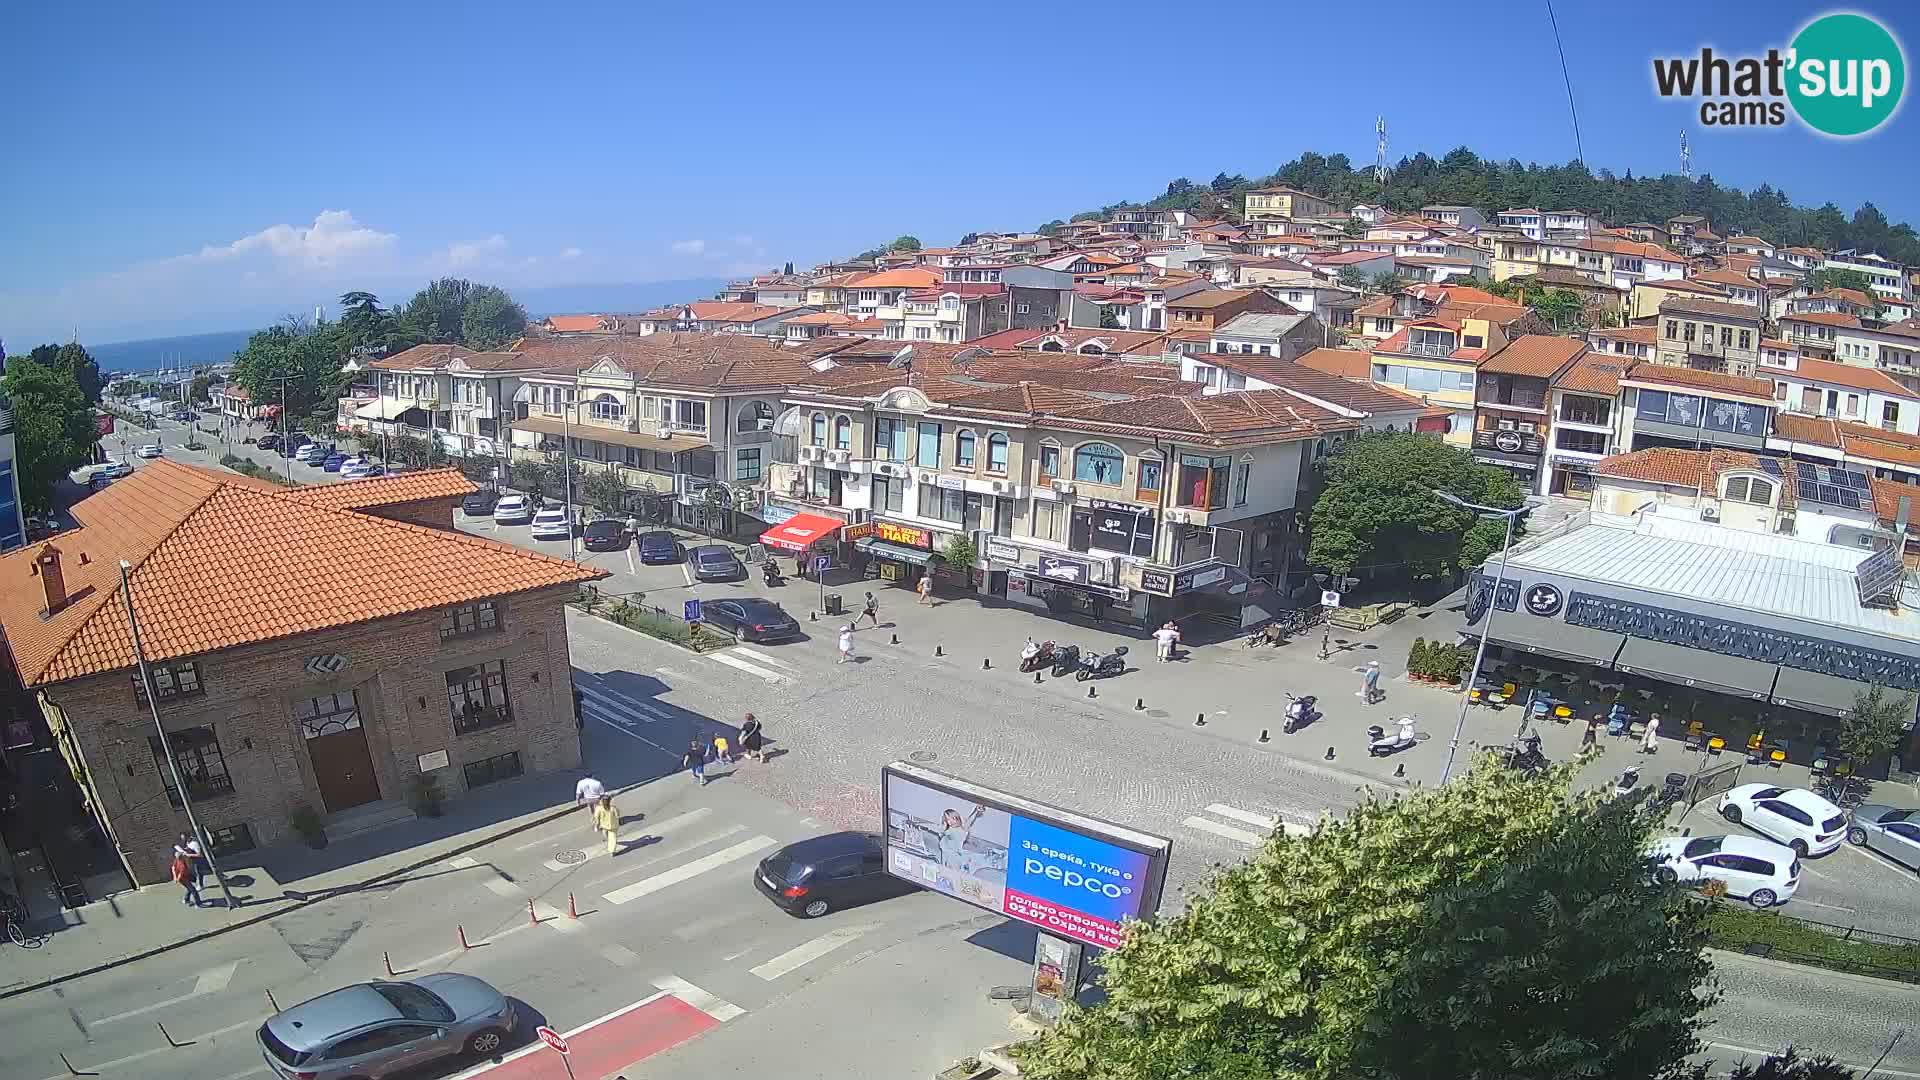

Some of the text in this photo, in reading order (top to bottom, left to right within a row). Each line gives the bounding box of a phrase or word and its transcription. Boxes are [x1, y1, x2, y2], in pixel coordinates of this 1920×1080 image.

[1022, 840, 1039, 851] За
[1089, 862, 1121, 877] тука
[1008, 902, 1047, 920] 02.07
[540, 1030, 567, 1049] STOP
